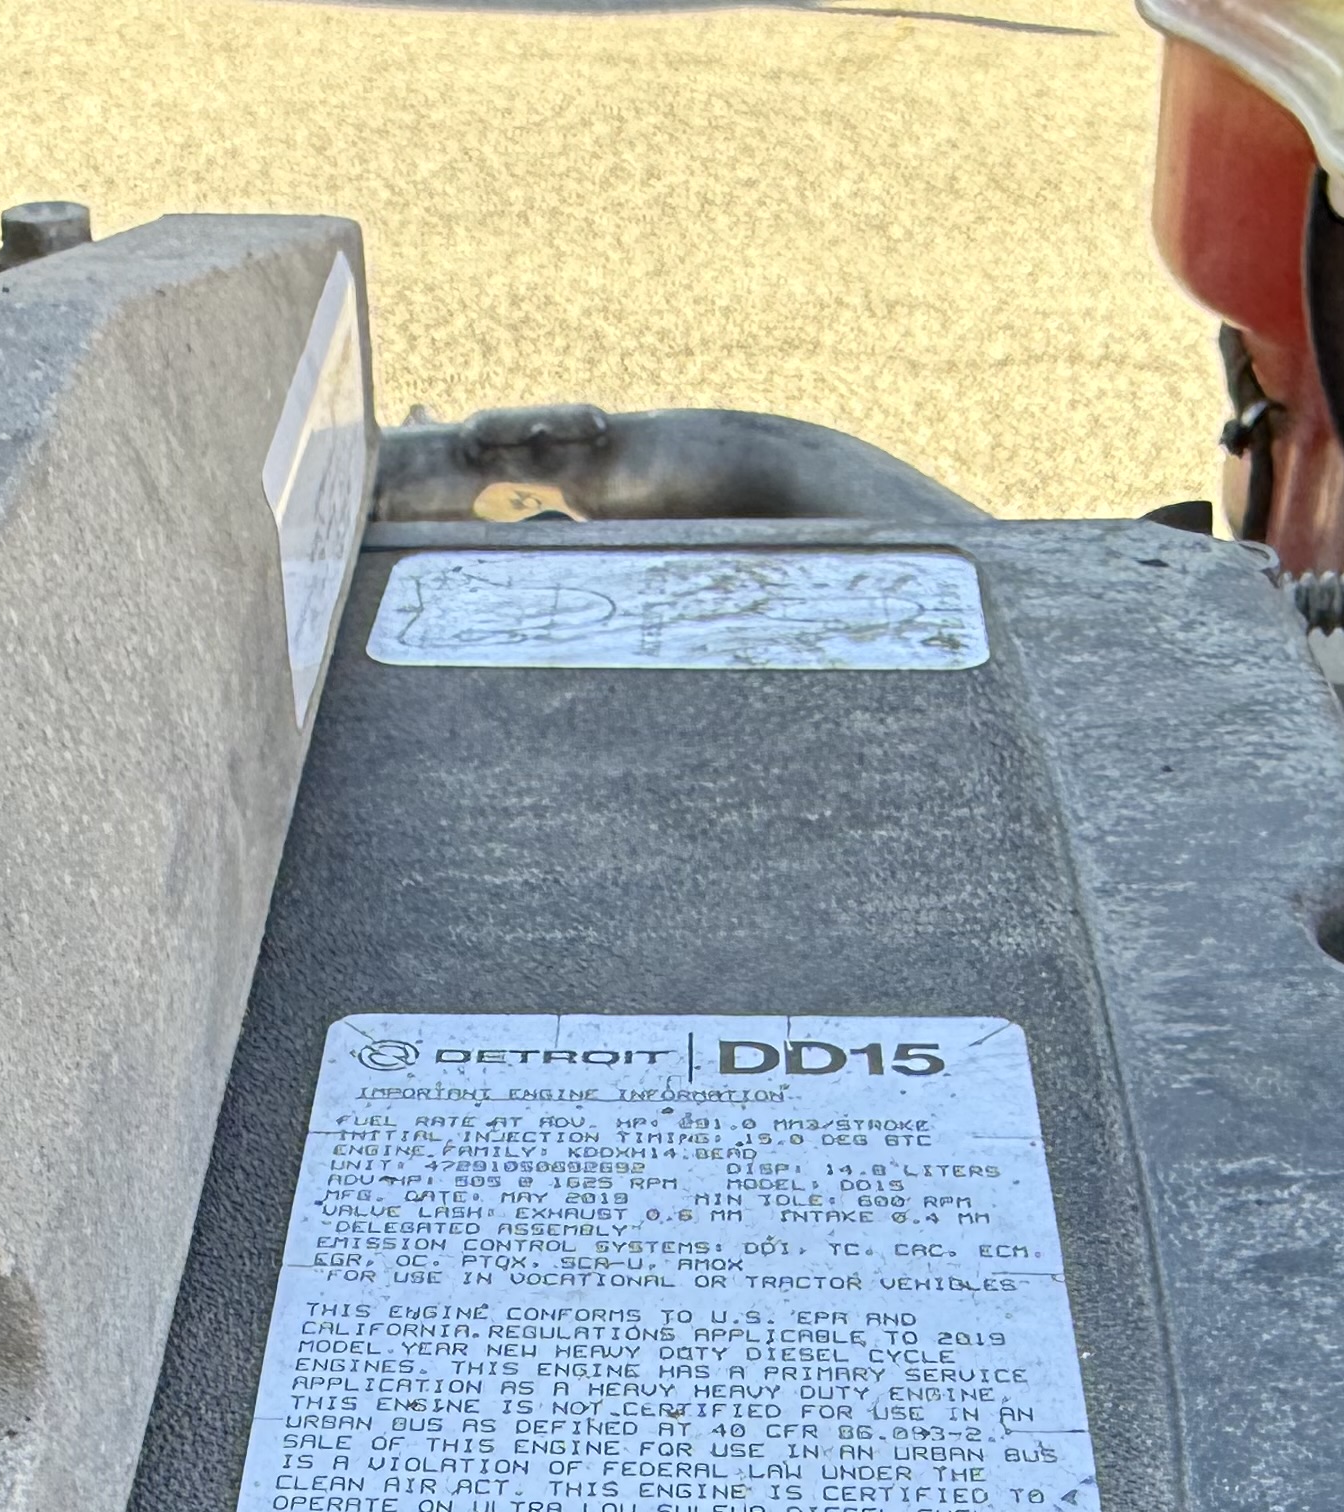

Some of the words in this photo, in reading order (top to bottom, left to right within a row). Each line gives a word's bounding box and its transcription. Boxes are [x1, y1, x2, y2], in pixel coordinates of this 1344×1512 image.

[435, 1048, 677, 1066] DETROIT
[718, 1039, 946, 1077] DD15
[336, 1115, 397, 1127] FUEL
[415, 1116, 477, 1128] RATE
[486, 1116, 523, 1128] AT
[464, 1130, 599, 1144] INJECTION
[821, 1134, 868, 1147] DEG
[885, 1135, 931, 1147] BTC
[442, 1145, 547, 1158] FAMILY:
[330, 1160, 404, 1173] UNIT:
[727, 1162, 800, 1175] DISP:
[904, 1164, 1000, 1178] LITERS
[630, 1178, 678, 1191] RPM
[727, 1178, 819, 1191] MODEL:
[324, 1190, 383, 1204] MFG.
[405, 1191, 483, 1205] DATE:
[501, 1192, 548, 1205] MAY
[695, 1194, 742, 1207] MIN
[758, 1194, 835, 1208] IDLE:
[858, 1195, 906, 1208] 600
[924, 1195, 971, 1208] RPM
[322, 1205, 401, 1219] VALVE
[418, 1206, 494, 1220] LASH:
[515, 1207, 627, 1221] EXHAUST
[711, 1209, 742, 1223] MM
[780, 1210, 873, 1224] INTAKE
[891, 1211, 939, 1224] 0.4
[958, 1212, 990, 1225] MM
[317, 1237, 446, 1251] EMISSION
[461, 1238, 576, 1253] CONTROL
[595, 1240, 722, 1255] SYSTEMS:
[678, 1257, 743, 1271] AMOX
[393, 1271, 443, 1286] USE
[463, 1272, 492, 1286] IN
[510, 1272, 676, 1289] VOCATIONAL
[695, 1275, 726, 1289] OR
[745, 1275, 862, 1291] TRACTOR
[307, 1303, 371, 1319] THIS
[389, 1304, 486, 1321] ENGINE
[507, 1306, 641, 1323] CONFORMS
[661, 1308, 692, 1323] TO
[711, 1309, 774, 1325] U.S.
[797, 1310, 848, 1326] EPA
[866, 1311, 916, 1326] AND
[488, 1324, 675, 1342] REGULATIONS
[694, 1327, 866, 1345] APPLICABLE
[882, 1330, 918, 1346] TO
[934, 1331, 1006, 1347] 2019
[402, 1341, 468, 1358] YEAR
[487, 1342, 536, 1358] NEW
[555, 1343, 640, 1360] HEAVY
[659, 1345, 729, 1361] DUTY
[746, 1346, 849, 1363] DIESEL
[869, 1348, 955, 1364] CYCLE
[295, 1358, 427, 1375] ENGINES.
[451, 1360, 518, 1376] THIS
[537, 1361, 640, 1378] ENGINE
[659, 1362, 710, 1379] HAS
[729, 1363, 746, 1379] A
[764, 1364, 885, 1381] PRIMARY
[905, 1366, 1028, 1383] SERVICE
[292, 1376, 482, 1395] APPLICATION
[500, 1380, 534, 1396] AS
[553, 1380, 569, 1397] A
[588, 1381, 677, 1398] HEAVY
[694, 1383, 780, 1400] HEAVY
[800, 1384, 870, 1401] DUTY
[291, 1395, 357, 1412] THIS
[376, 1396, 480, 1414] ENGINE
[502, 1398, 533, 1415] IS
[552, 1399, 601, 1416] NOT
[623, 1400, 781, 1419] CERTIFIED
[802, 1403, 852, 1420] FOR
[871, 1404, 924, 1421] USE
[949, 1405, 979, 1422] IN
[999, 1406, 1033, 1422] AN
[286, 1414, 372, 1432] URBAN
[392, 1416, 443, 1433] BUS
[462, 1417, 496, 1434] AS
[516, 1418, 638, 1437] DEFINED
[659, 1420, 691, 1437] AT
[713, 1421, 745, 1438] 40
[767, 1422, 817, 1440] CFR
[283, 1433, 352, 1451] SALE
[372, 1435, 405, 1452] OF
[426, 1436, 495, 1454] THIS
[514, 1437, 619, 1456] ENGINE
[640, 1440, 692, 1458] FOR
[710, 1441, 764, 1459] USE
[788, 1443, 818, 1460] IN
[840, 1444, 879, 1461] AN
[894, 1445, 984, 1463] URBAN
[1004, 1447, 1058, 1465] BUS
[283, 1453, 313, 1471] IS
[333, 1454, 349, 1471] A
[368, 1455, 529, 1475] VIOLATION
[549, 1458, 582, 1476] OF
[603, 1459, 728, 1479] FEDERAL
[748, 1462, 802, 1480] LAW
[822, 1463, 911, 1482] UNDER
[933, 1465, 986, 1484] THE
[275, 1475, 364, 1494] CLEAN
[384, 1477, 437, 1495] AIR
[457, 1479, 523, 1497] ACT.
[549, 1480, 618, 1499] THIS
[639, 1482, 747, 1501] ENGINE
[769, 1484, 803, 1502] IS
[823, 1485, 988, 1505] CERTIFIED
[1009, 1488, 1045, 1506] TO
